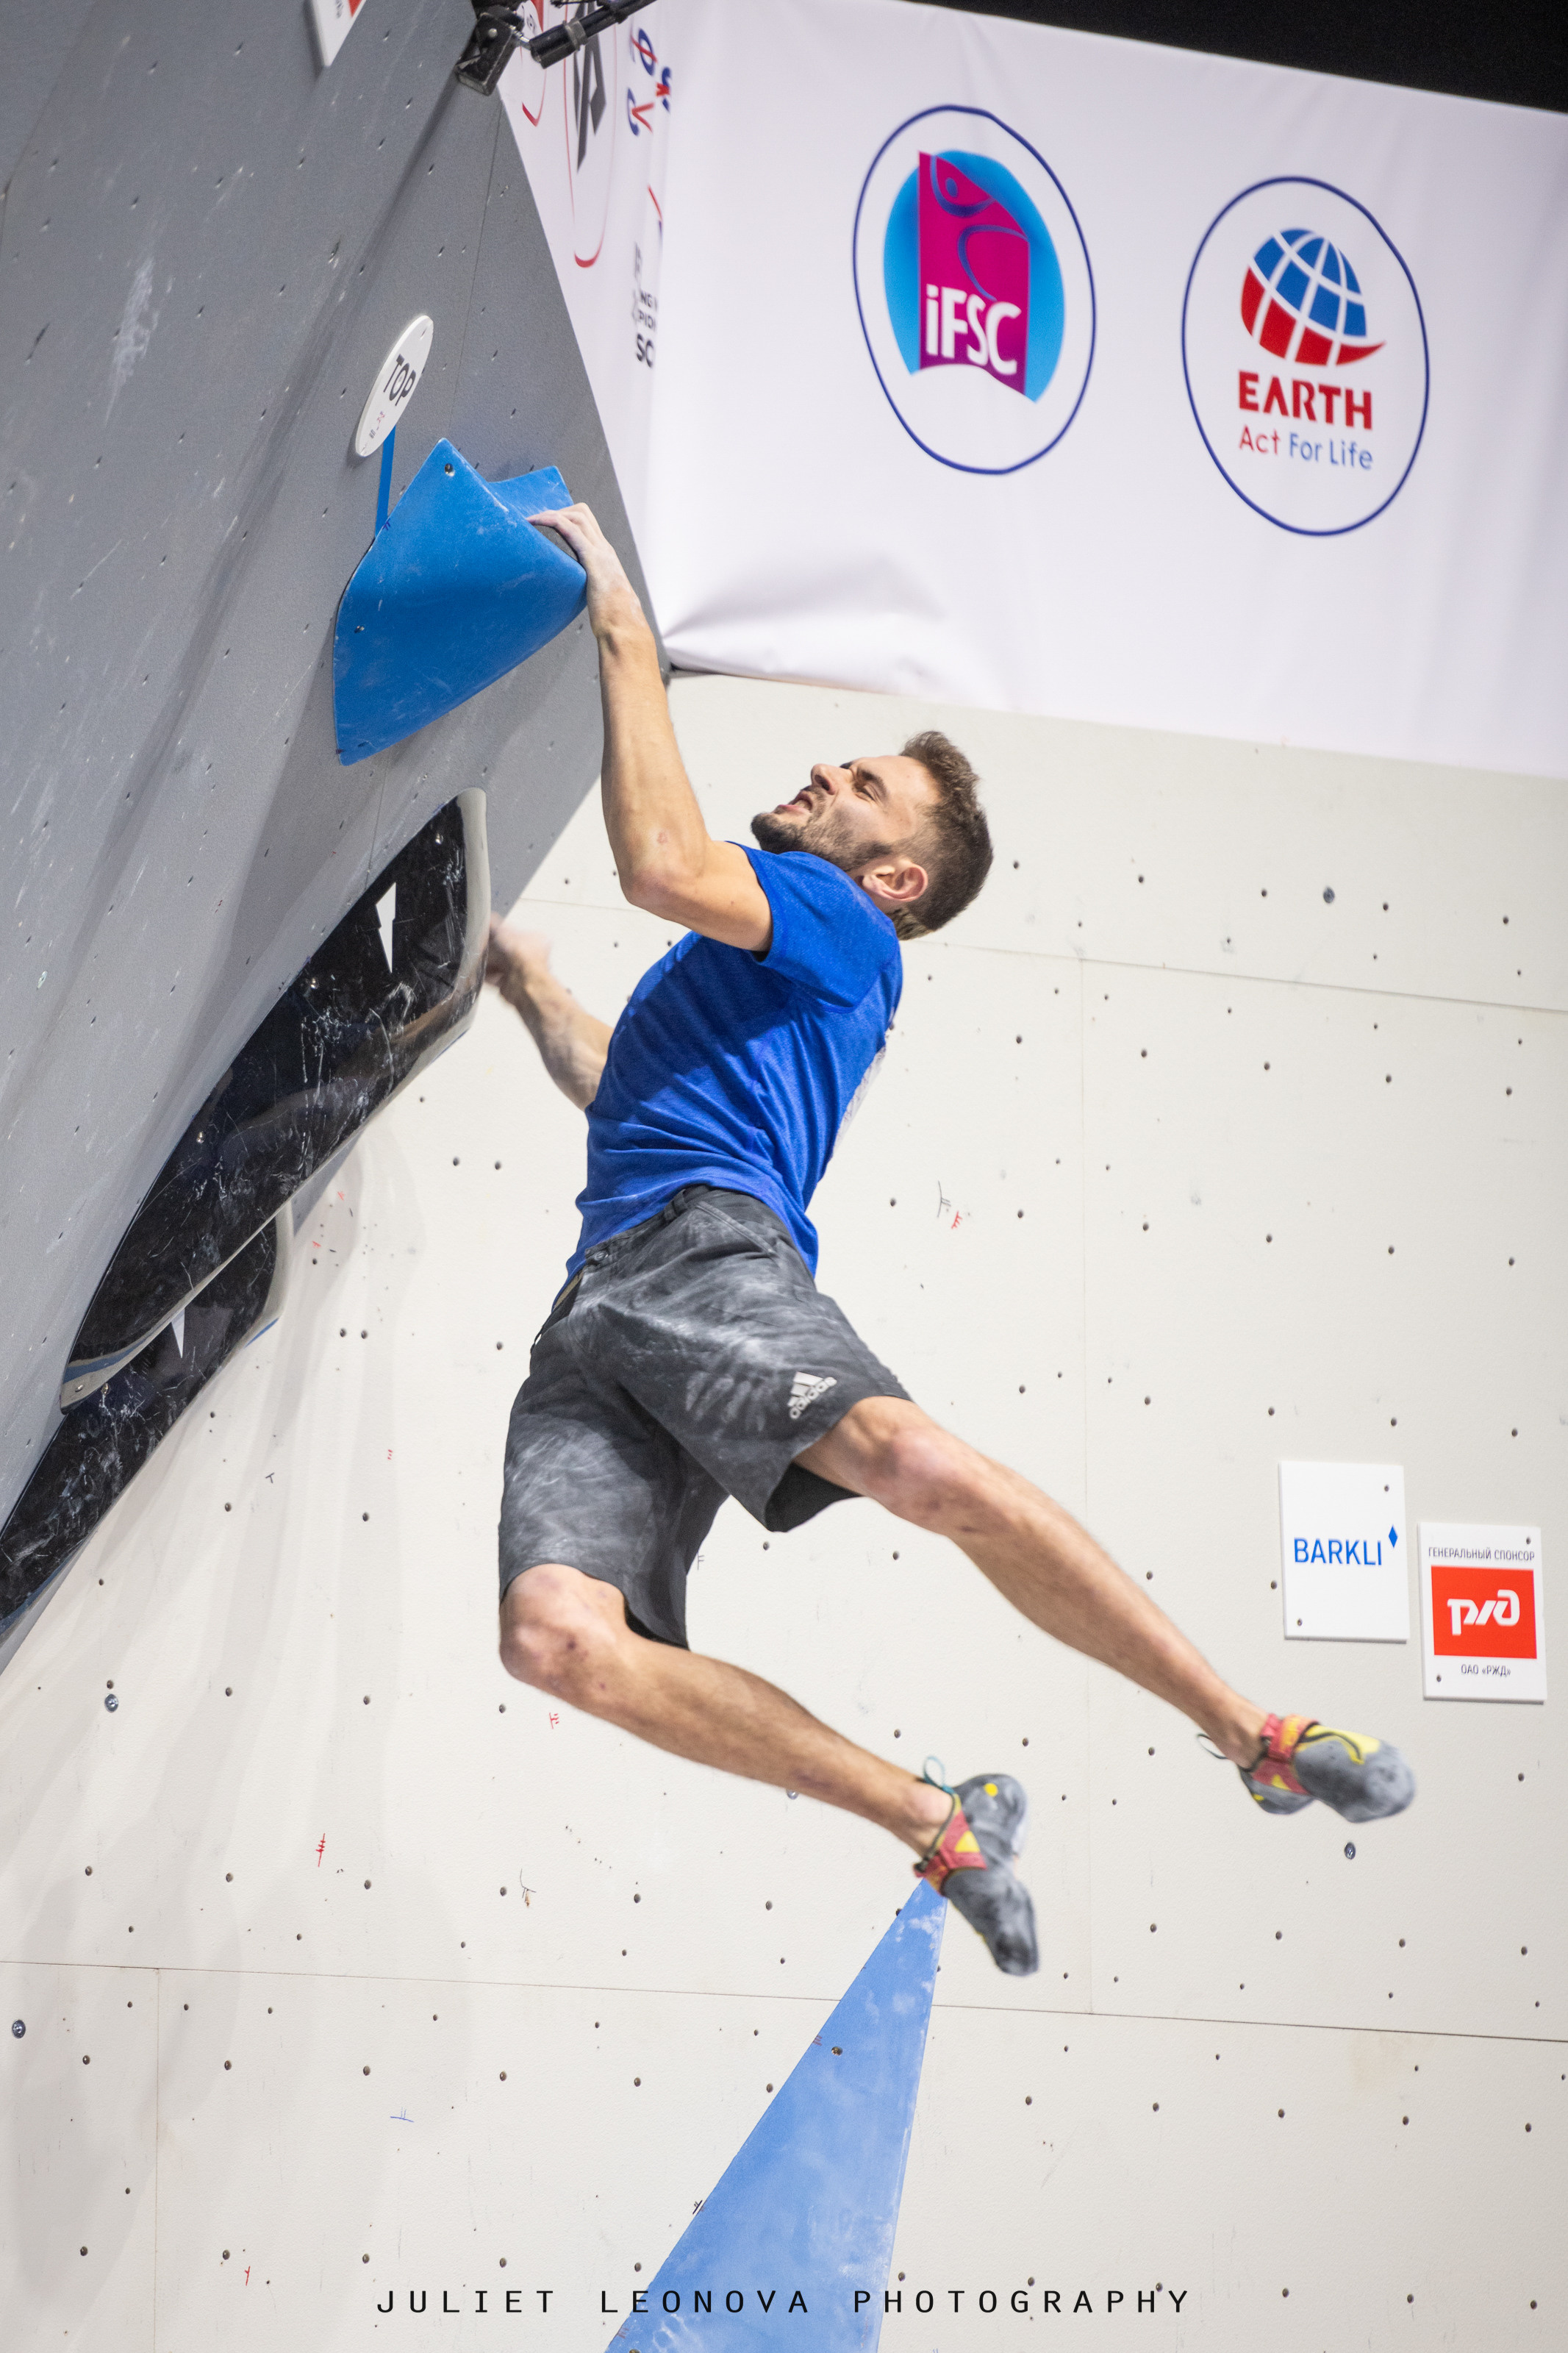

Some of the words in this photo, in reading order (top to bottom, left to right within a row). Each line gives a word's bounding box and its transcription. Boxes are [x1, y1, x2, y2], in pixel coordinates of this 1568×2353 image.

[383, 353, 417, 407] TOP
[1239, 369, 1373, 431] EARTH
[1239, 424, 1281, 456] Act
[1289, 432, 1323, 463] For
[1329, 439, 1373, 471] Life
[788, 1376, 838, 1420] adidas
[1293, 1537, 1382, 1566] BARKLI
[1428, 1546, 1492, 1560] ГЕНЕРАЛЬНЫЙ
[1494, 1549, 1535, 1561] СПОНСОР
[1461, 1663, 1479, 1675] ОАО
